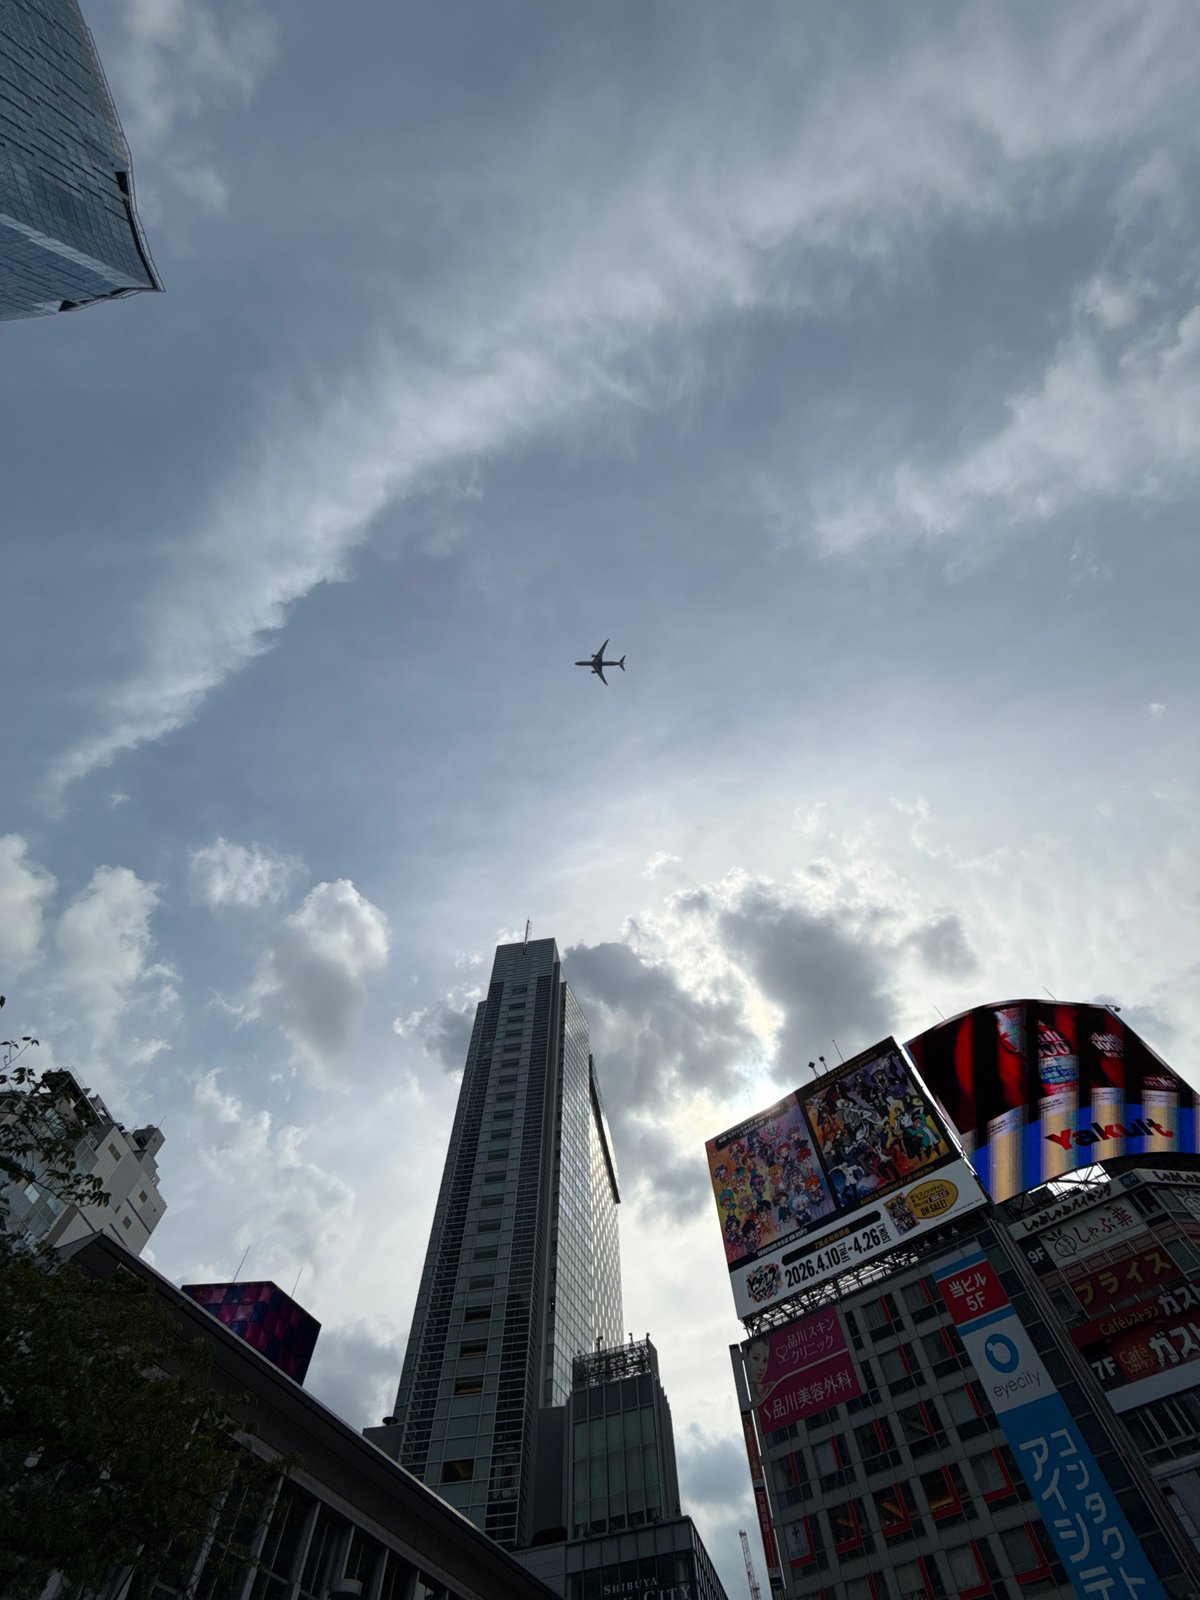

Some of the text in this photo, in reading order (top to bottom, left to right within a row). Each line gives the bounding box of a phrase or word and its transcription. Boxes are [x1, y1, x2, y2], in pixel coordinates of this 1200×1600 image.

[1044, 1117, 1175, 1151] Yakult
[1073, 1206, 1133, 1244] しゃぶ葉
[1027, 1247, 1045, 1264] 9F
[949, 1272, 987, 1299] 当ビル
[965, 1291, 986, 1312] 5F
[787, 1318, 835, 1350] 品川スキン
[790, 1335, 834, 1364] クリニック
[1091, 1356, 1118, 1380] 7F
[772, 1368, 853, 1420] 品川美容外科
[993, 1370, 1041, 1399] eyecity
[603, 1577, 657, 1595] SHIBUYA
